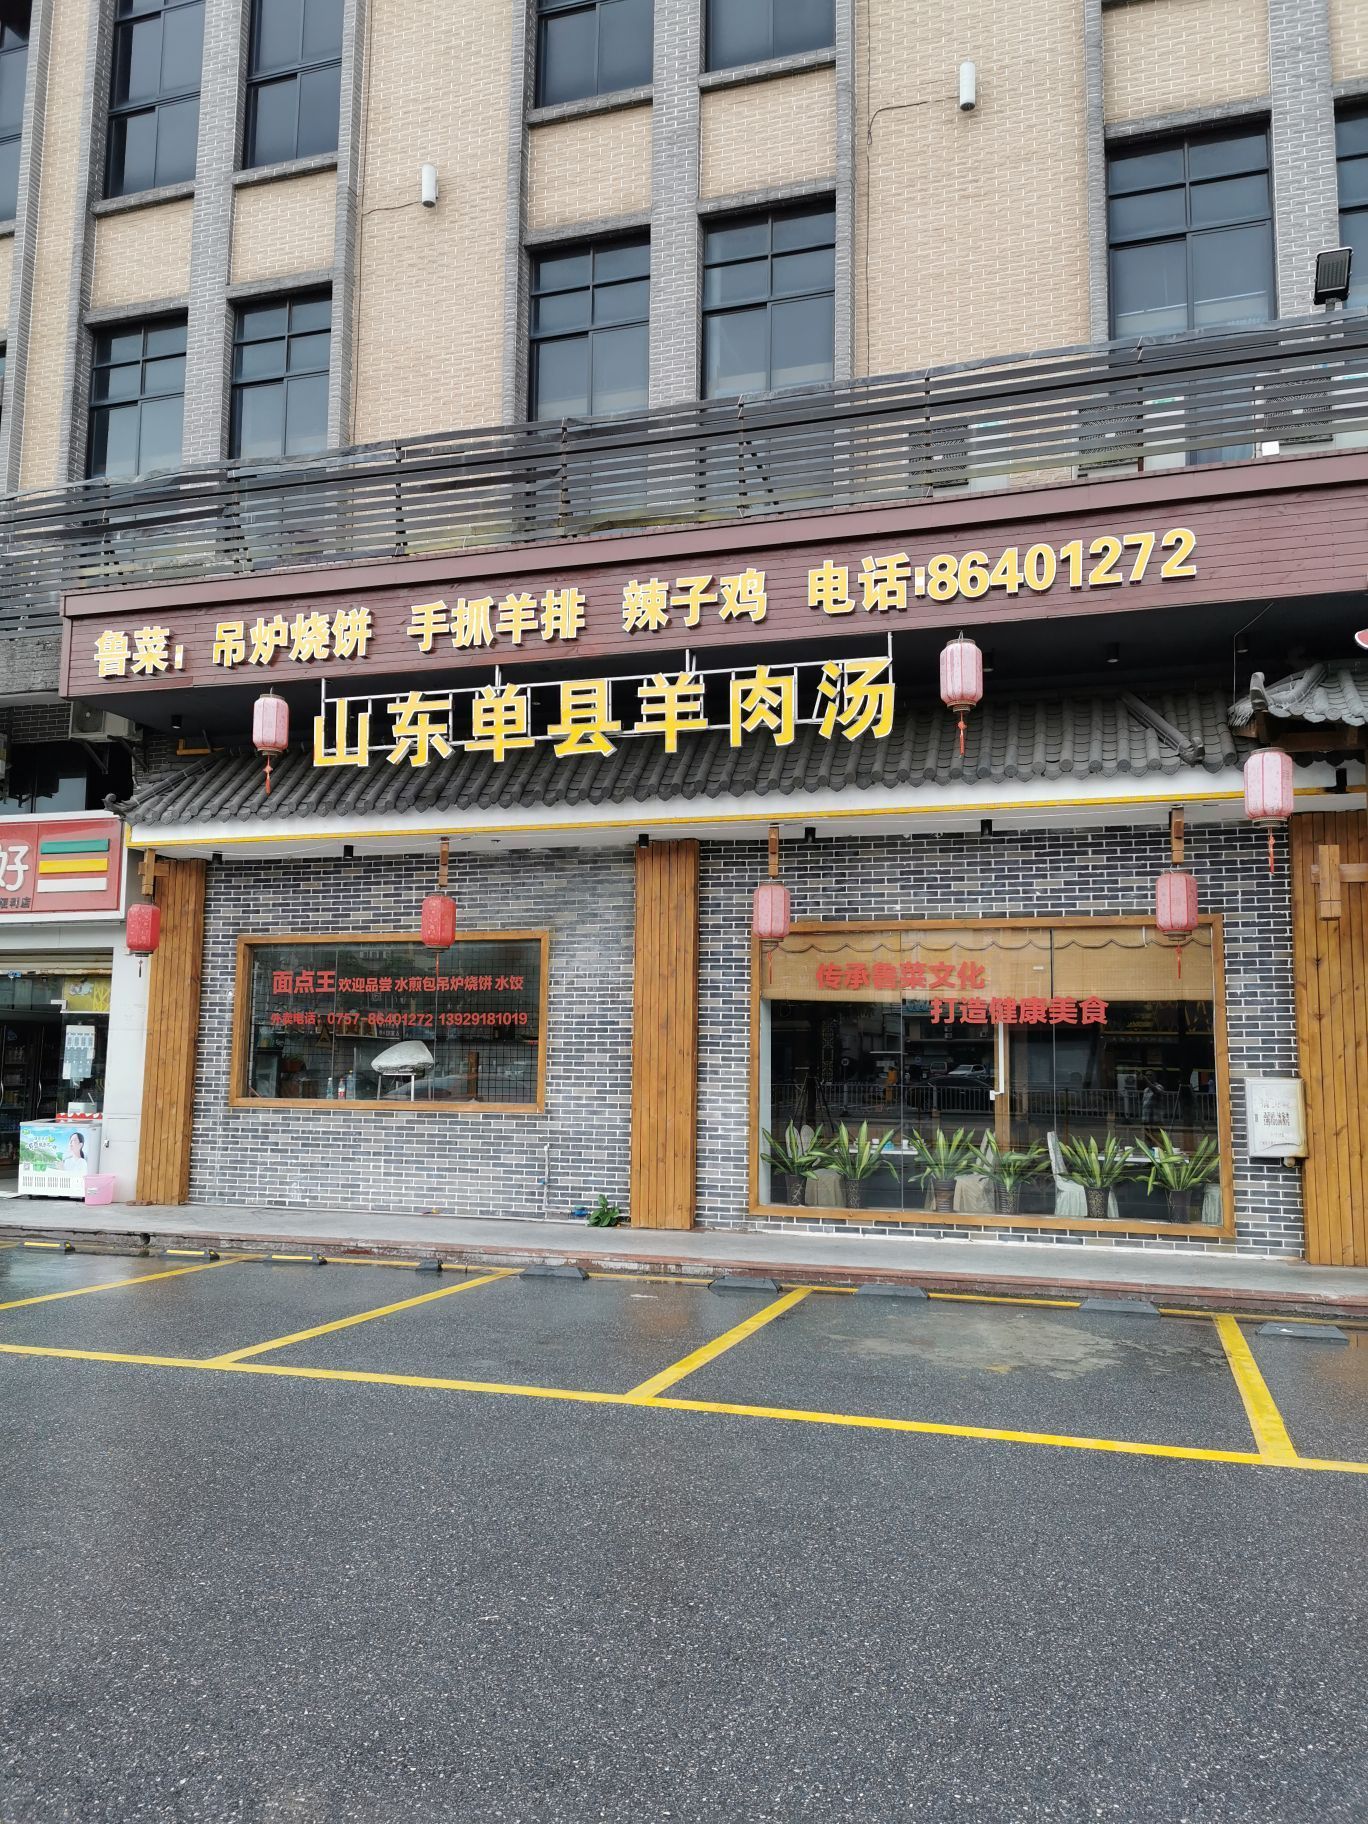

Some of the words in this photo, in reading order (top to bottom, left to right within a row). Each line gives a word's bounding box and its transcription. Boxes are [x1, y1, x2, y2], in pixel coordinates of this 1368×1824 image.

[212, 608, 373, 667] 吊炉烧饼
[407, 587, 587, 652] 手抓羊排
[622, 567, 767, 633] 辣子鸡
[313, 656, 896, 768] 山东单县羊肉汤
[272, 970, 336, 995] 面点王
[338, 977, 392, 993] 欢迎品尝
[494, 975, 524, 992] 水饺
[815, 961, 987, 990] 传承鲁菜文化
[438, 1012, 529, 1026] 13929181019
[930, 996, 1109, 1025] 打造健康美食
